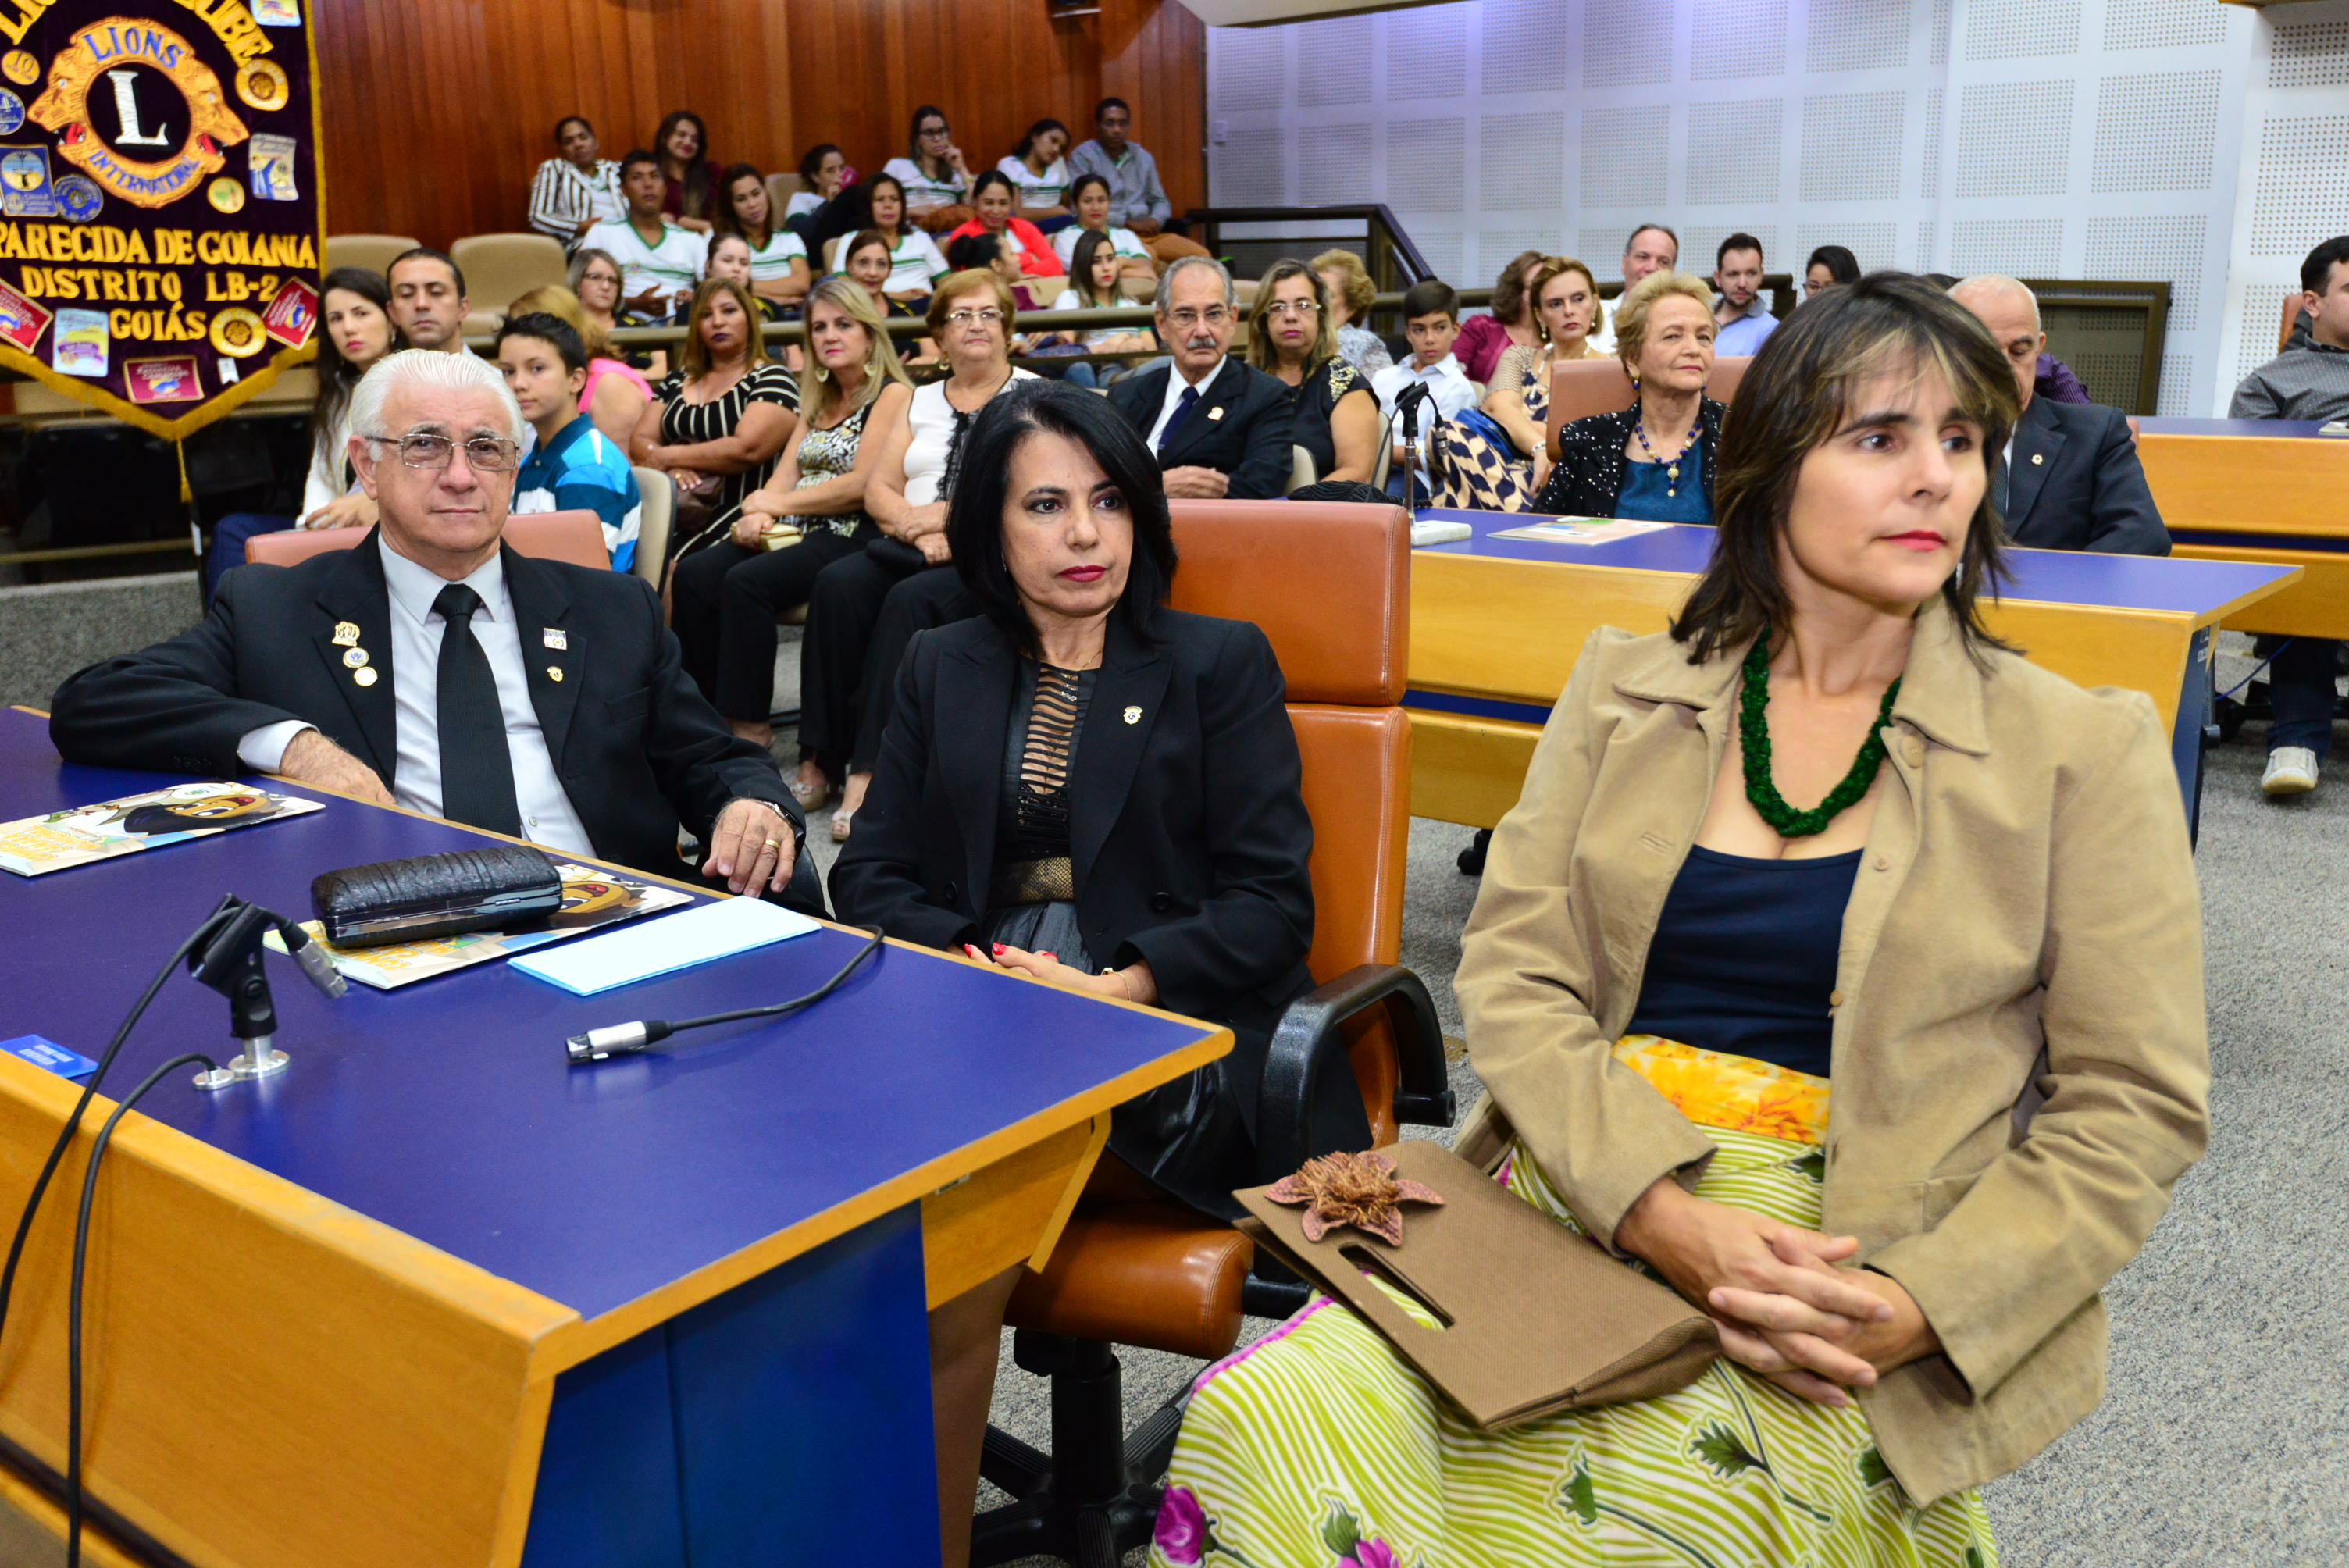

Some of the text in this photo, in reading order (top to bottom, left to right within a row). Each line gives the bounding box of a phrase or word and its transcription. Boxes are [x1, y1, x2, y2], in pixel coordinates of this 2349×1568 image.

[83, 27, 184, 69] LIONS
[171, 0, 274, 68] UBE
[106, 70, 169, 145] L
[154, 228, 195, 265] DE
[20, 265, 280, 301] DISTRITO LB-2
[109, 301, 206, 341] GOIÁS
